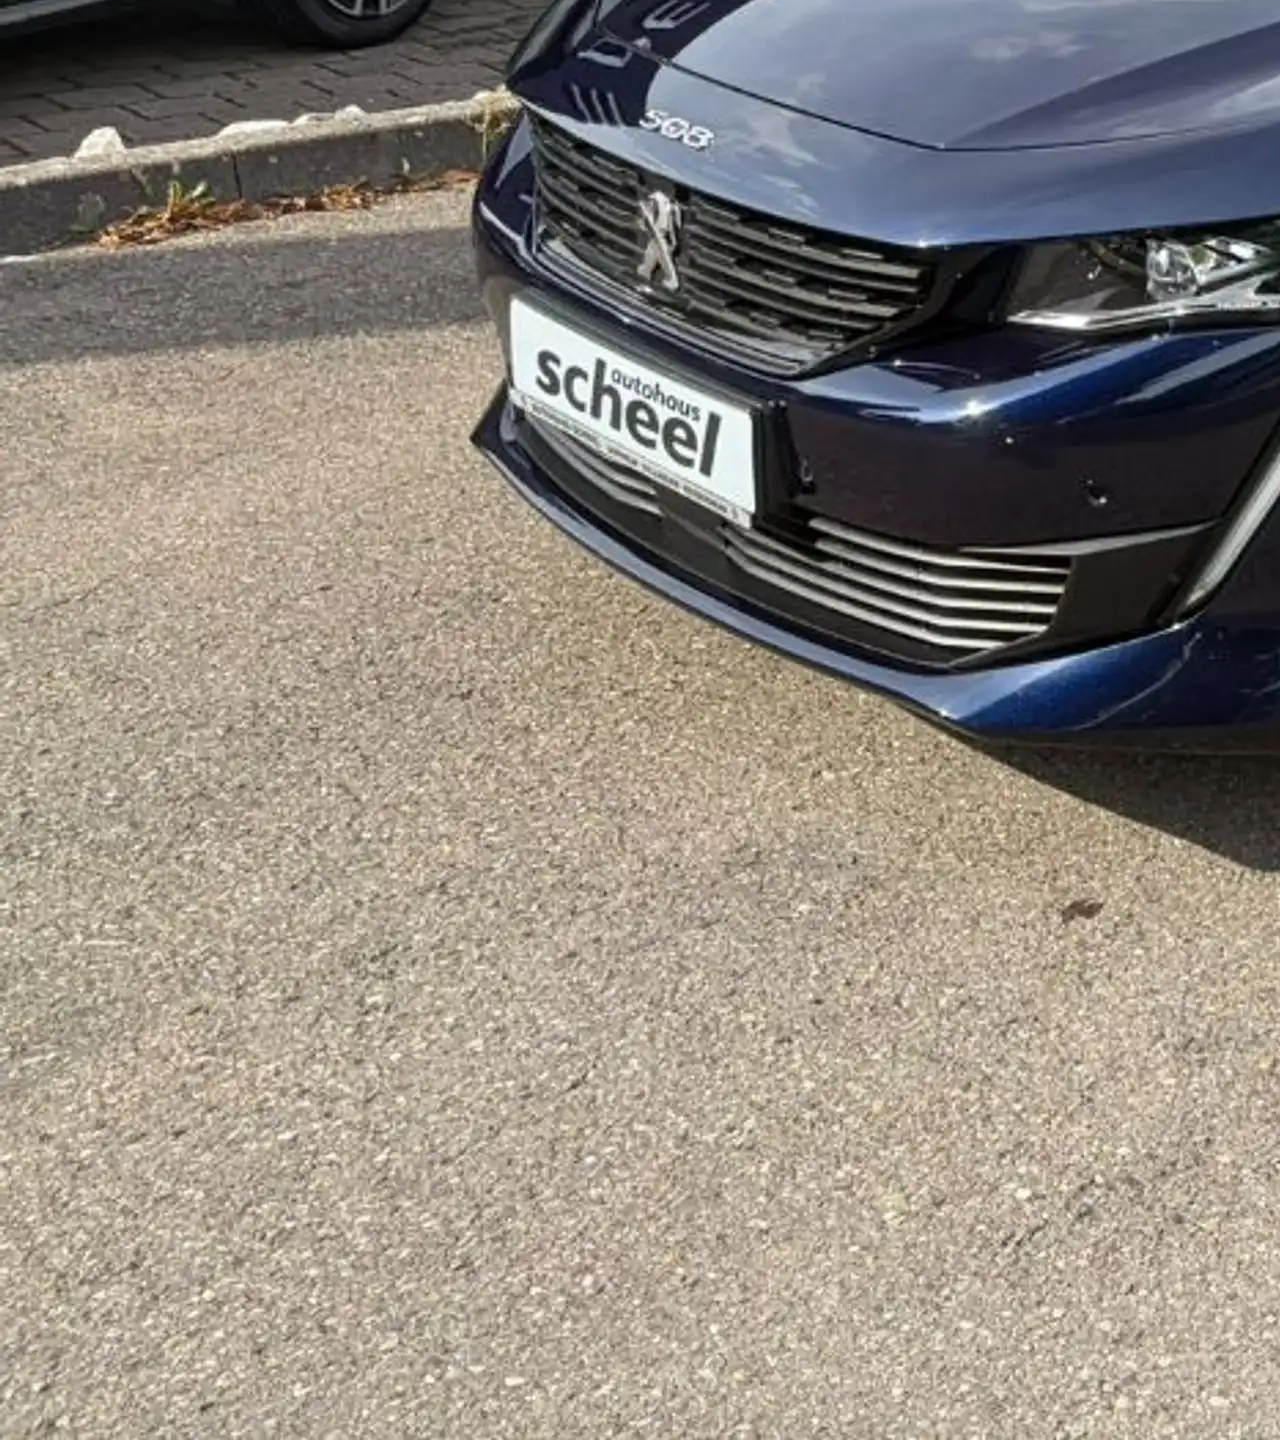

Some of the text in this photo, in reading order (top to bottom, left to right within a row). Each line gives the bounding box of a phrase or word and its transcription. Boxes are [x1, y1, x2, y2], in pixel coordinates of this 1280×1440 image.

[639, 110, 714, 149] 508
[535, 348, 722, 478] scheel
[611, 368, 702, 422] autohaus
